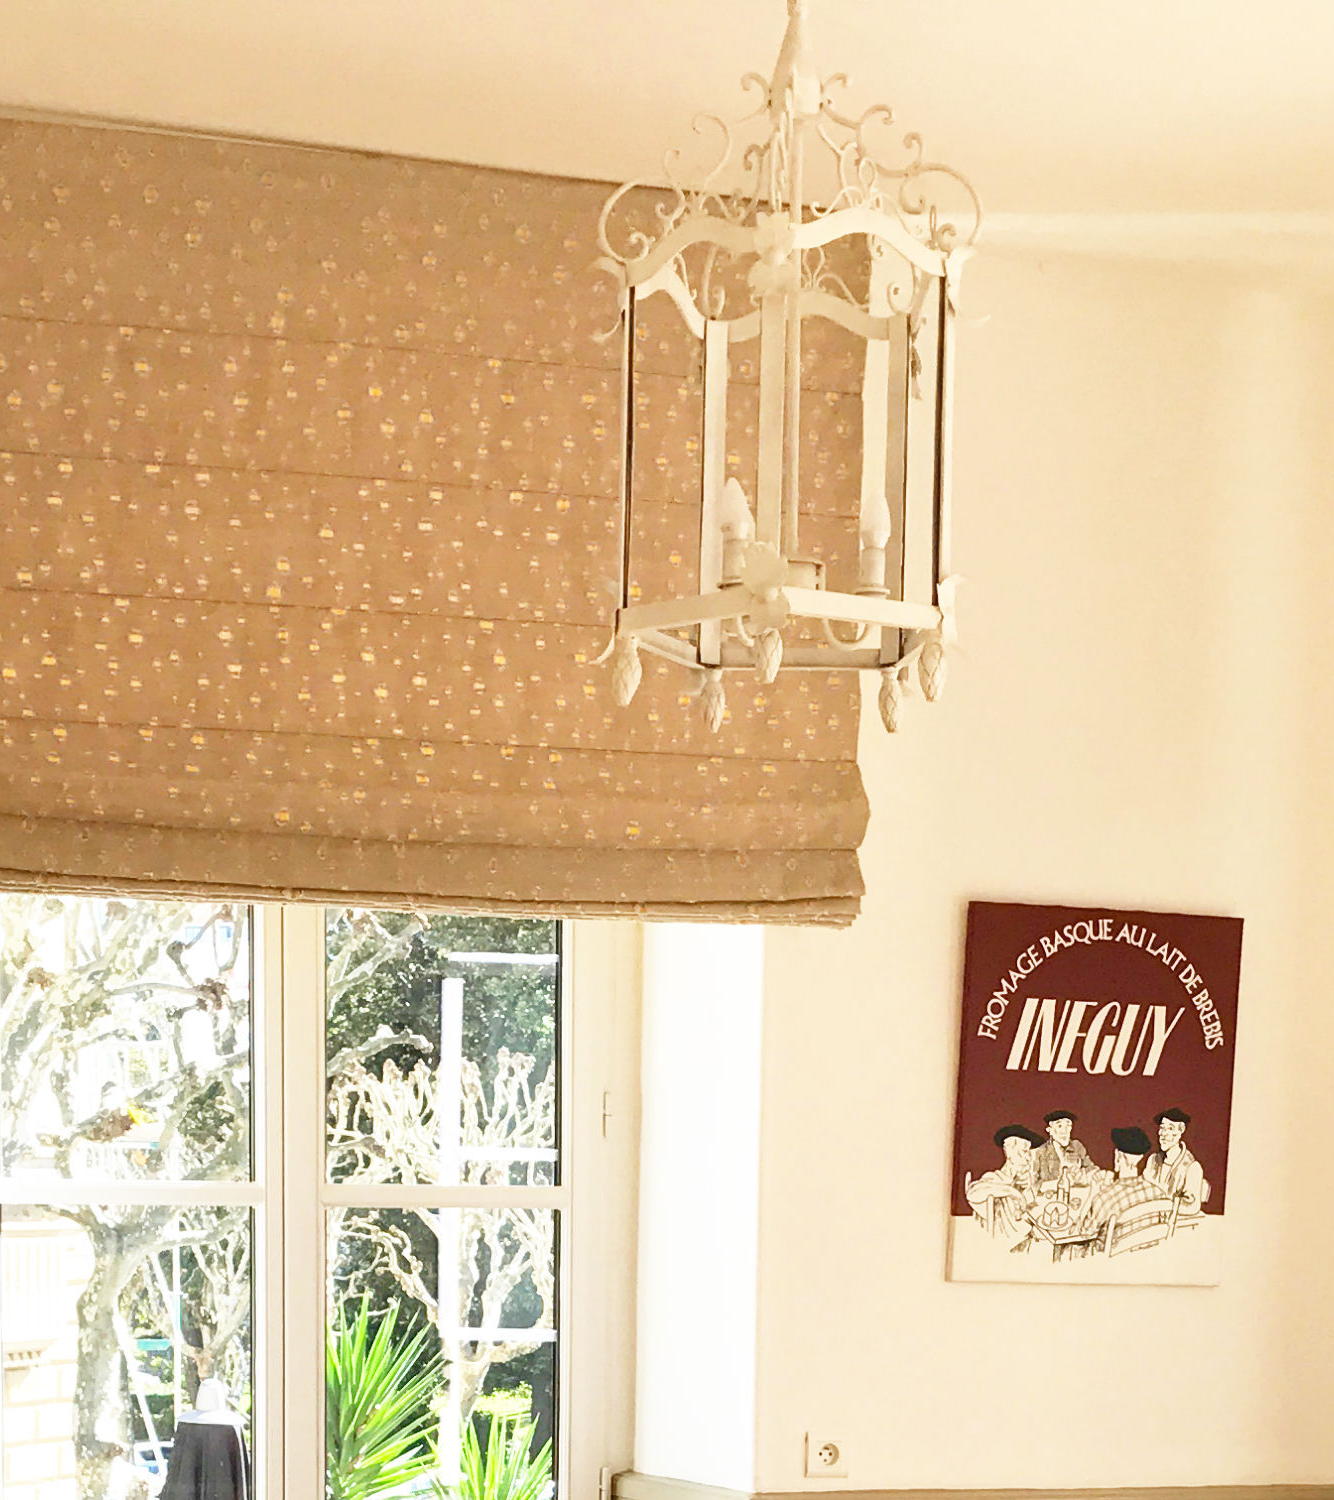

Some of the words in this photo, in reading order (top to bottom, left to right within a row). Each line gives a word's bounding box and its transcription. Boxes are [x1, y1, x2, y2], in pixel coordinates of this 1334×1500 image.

[977, 945, 1043, 1040] FROMAGE
[1039, 918, 1114, 959] BASQUE
[1115, 922, 1147, 949] AU
[1145, 932, 1187, 972] LAIT
[1178, 963, 1203, 995] DE
[1192, 988, 1224, 1051] BREBIS
[1005, 997, 1186, 1077] INEGUY
